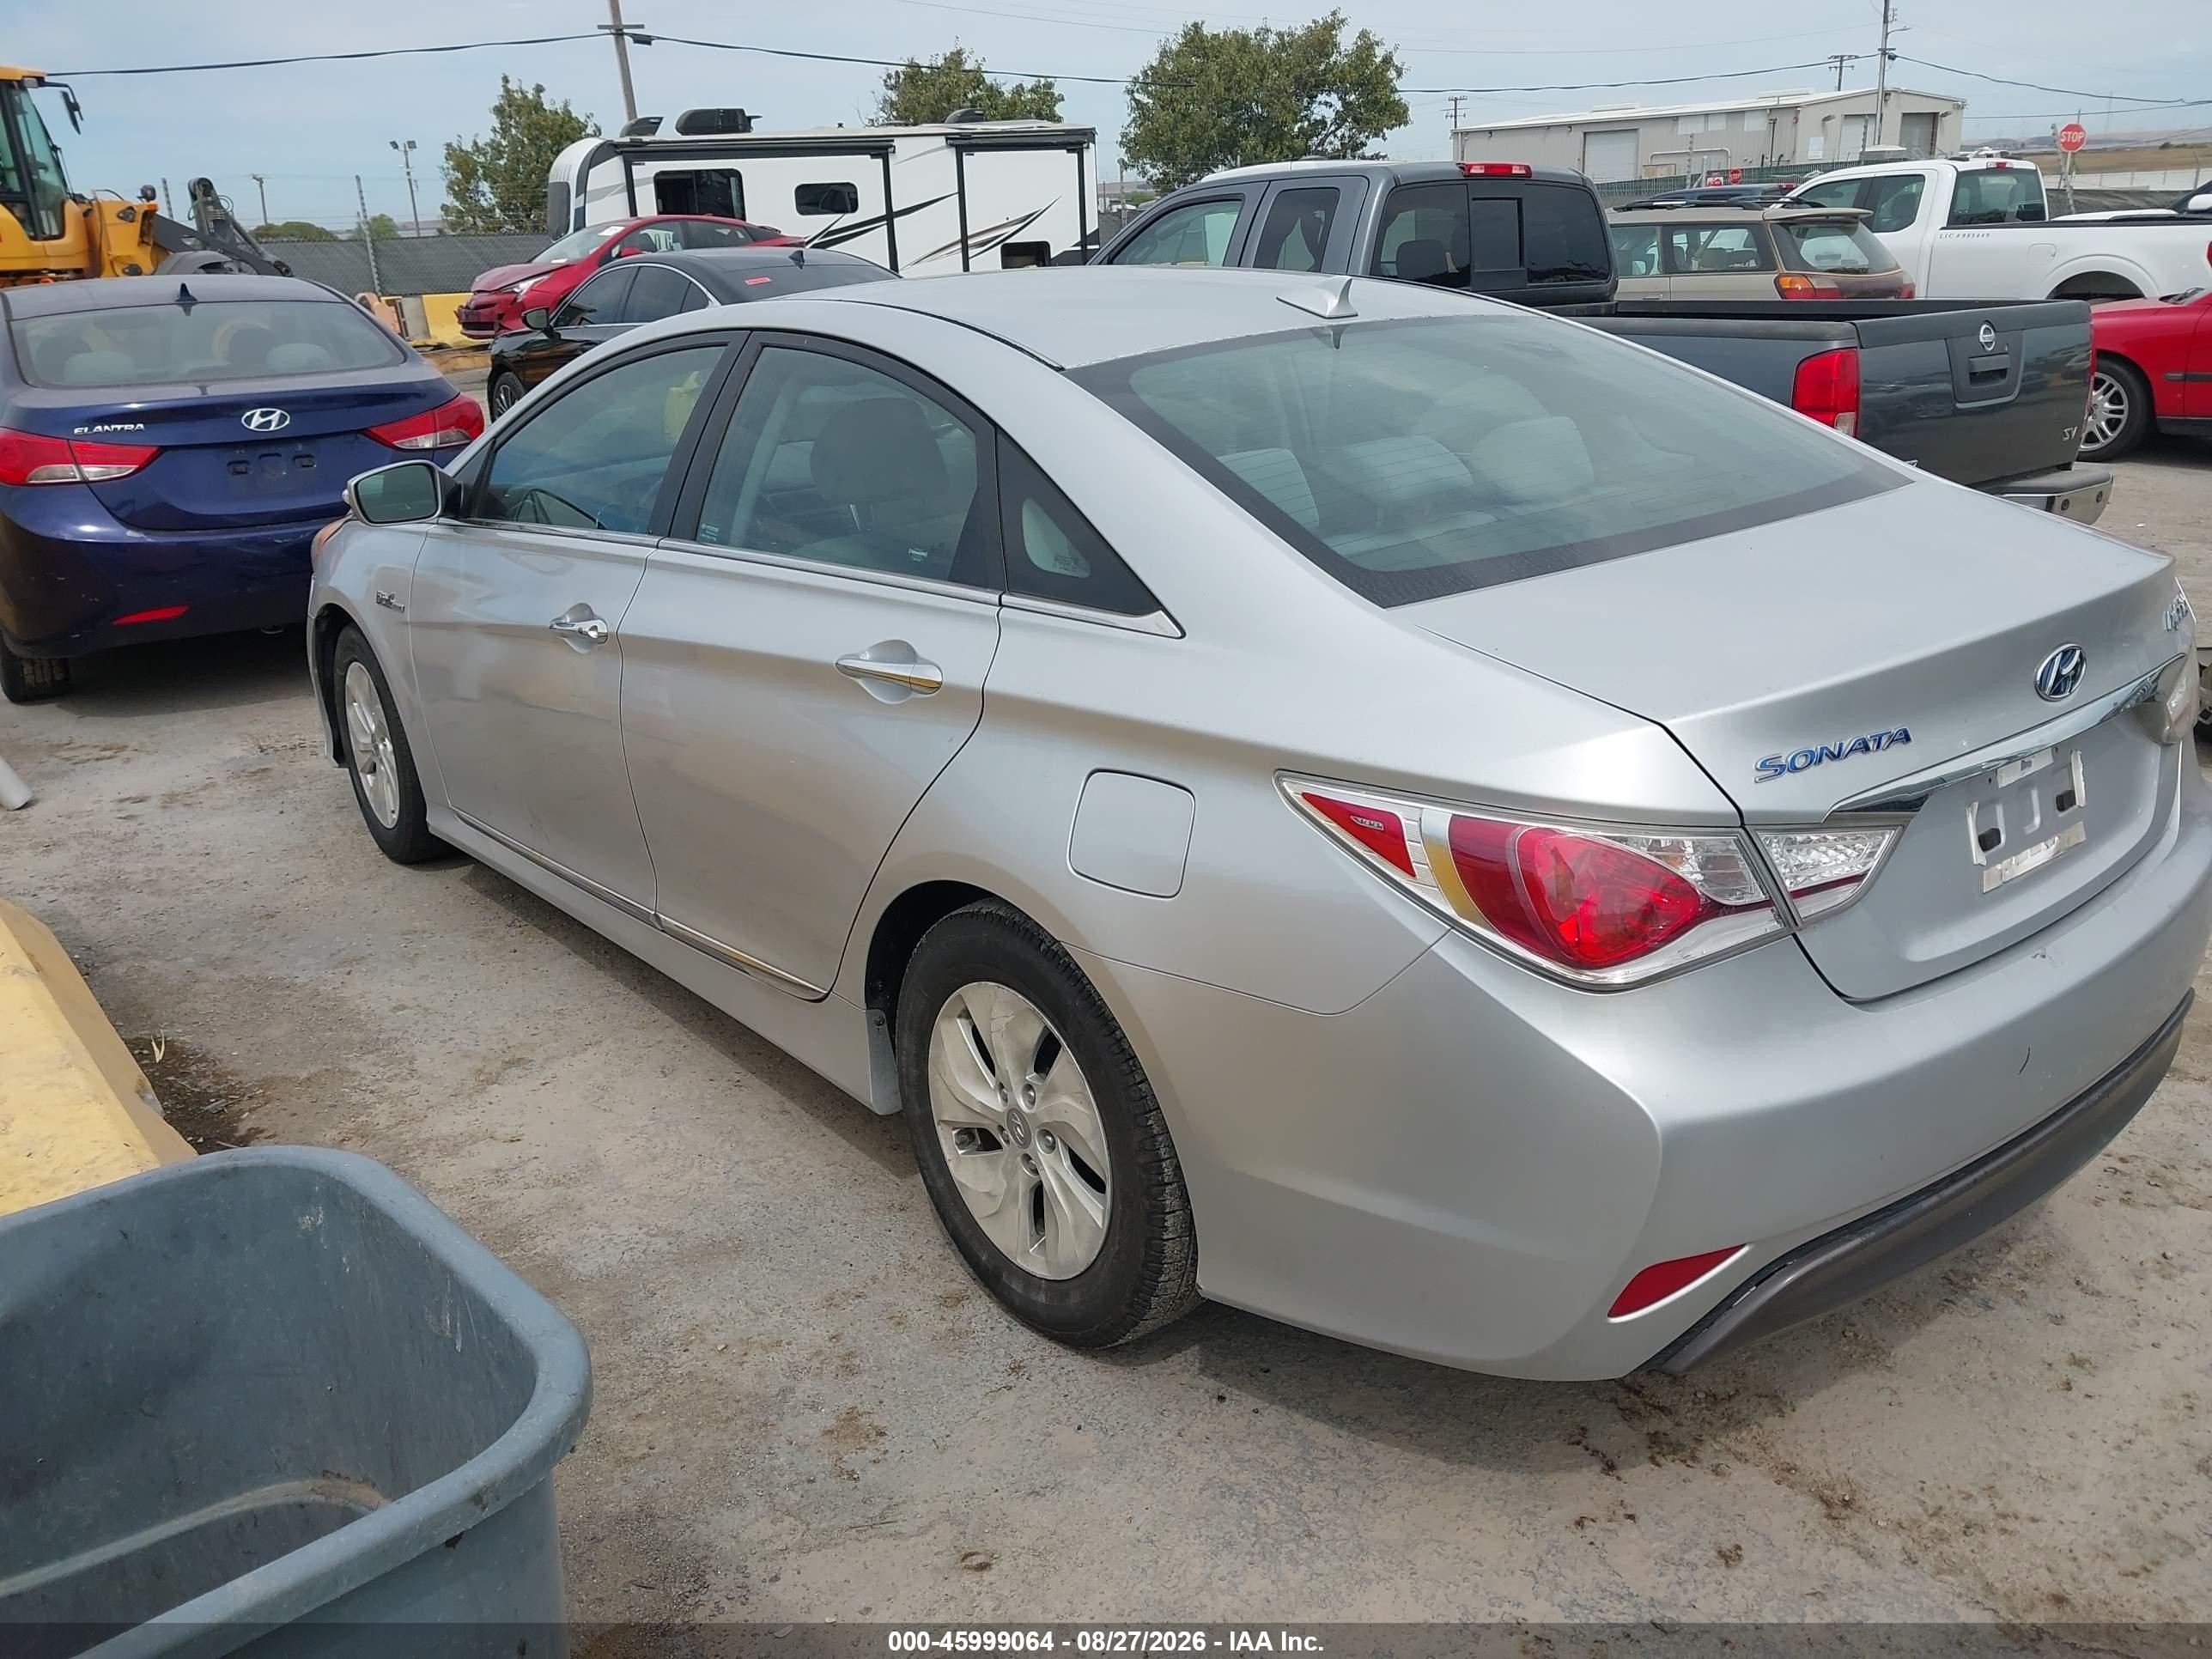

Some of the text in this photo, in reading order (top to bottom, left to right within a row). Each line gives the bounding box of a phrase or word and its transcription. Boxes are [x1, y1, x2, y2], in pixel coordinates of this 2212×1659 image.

[2060, 131, 2085, 143] STOP
[74, 423, 145, 435] ELANTRA
[2063, 426, 2078, 441] SV
[1753, 726, 1912, 783] SONATA
